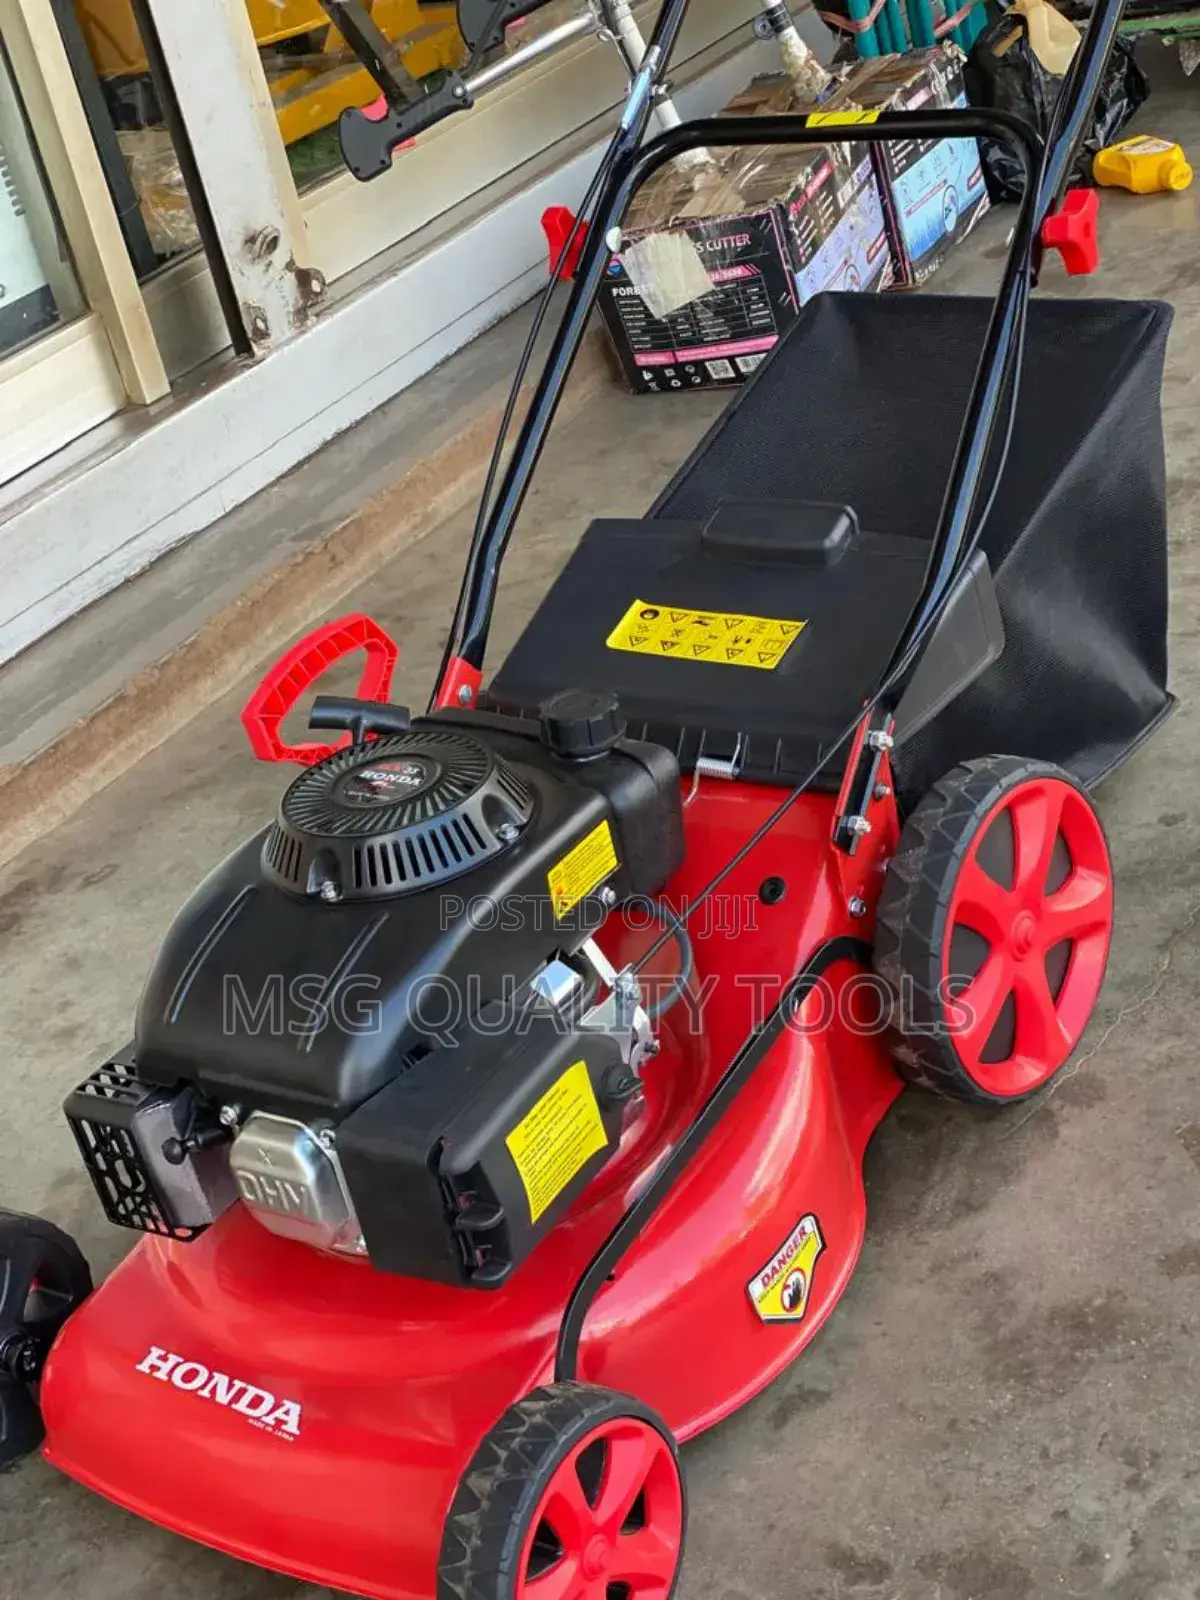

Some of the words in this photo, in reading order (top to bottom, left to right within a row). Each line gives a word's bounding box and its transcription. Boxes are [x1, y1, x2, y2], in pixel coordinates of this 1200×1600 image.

[706, 234, 752, 251] CUTTER
[359, 769, 422, 786] HONDA
[761, 1226, 807, 1288] DANGER
[135, 1345, 302, 1435] HONDA
